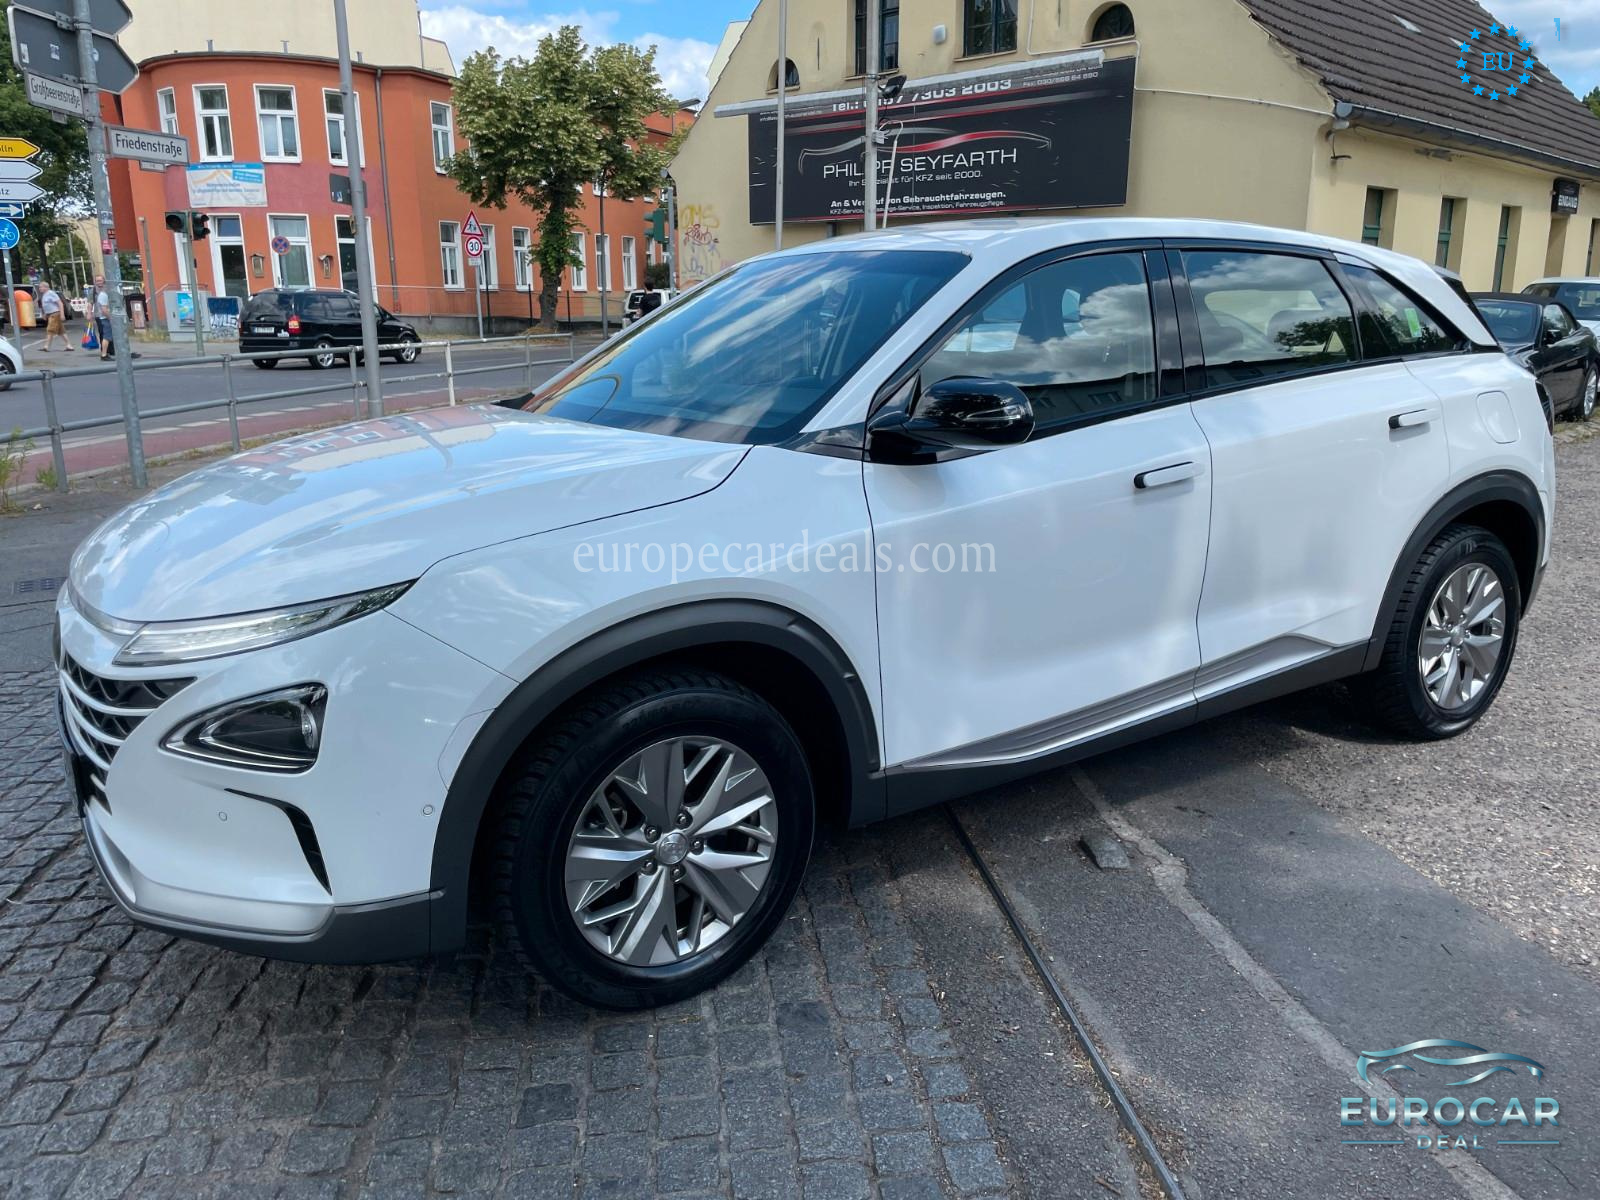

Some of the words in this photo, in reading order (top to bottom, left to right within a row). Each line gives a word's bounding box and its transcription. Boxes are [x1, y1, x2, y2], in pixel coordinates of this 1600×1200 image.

[863, 96, 903, 107] 157
[962, 79, 1011, 95] 2003
[115, 133, 182, 157] Friedenstraße
[823, 160, 895, 178] PHILP
[900, 148, 1017, 172] SEYFARTH
[901, 175, 914, 183] für
[915, 174, 934, 182] KFZ
[935, 172, 952, 180] seit
[954, 170, 983, 179] 2000.
[902, 191, 1007, 204] Gebrauchtfahrzeugen.
[469, 241, 479, 251] 30
